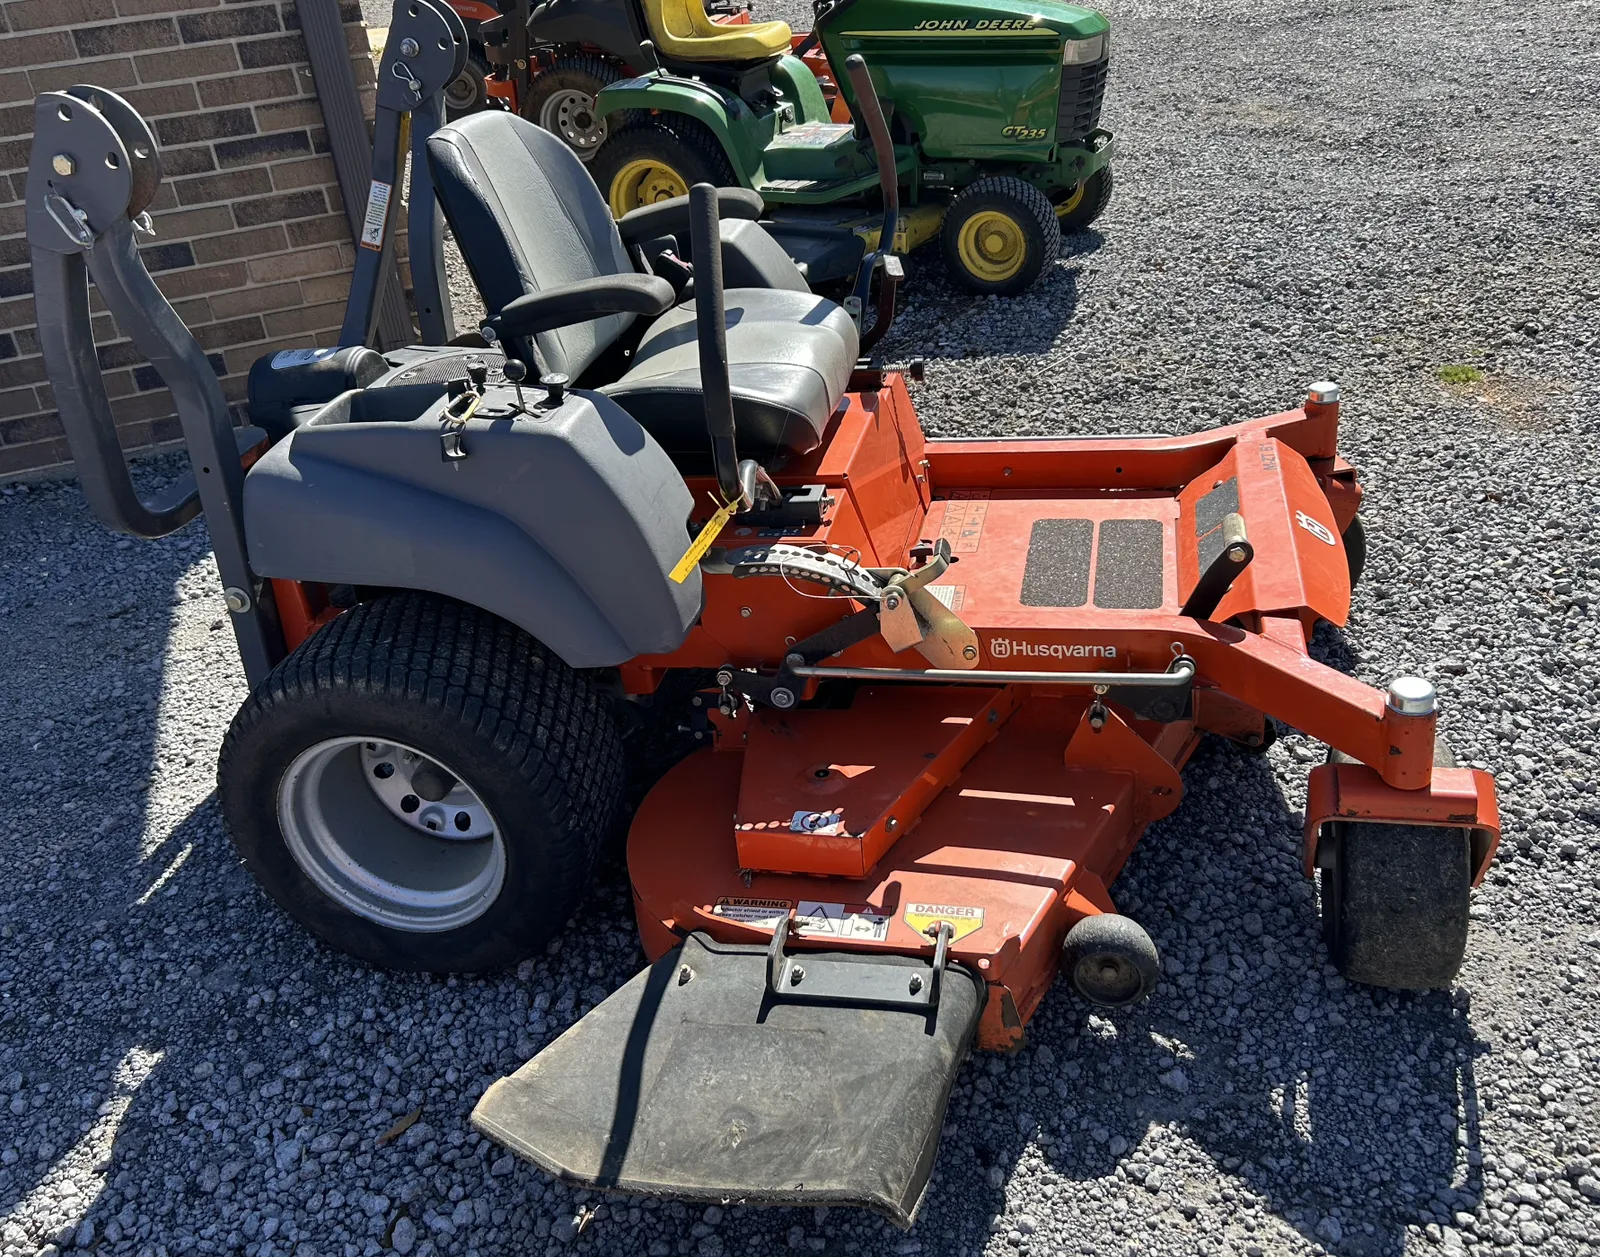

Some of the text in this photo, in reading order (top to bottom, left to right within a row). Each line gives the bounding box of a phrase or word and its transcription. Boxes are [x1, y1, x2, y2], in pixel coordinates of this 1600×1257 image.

[914, 19, 1036, 31] JOHN DEERE
[1001, 125, 1048, 140] GT235
[1013, 640, 1117, 659] Husqvarna
[733, 898, 788, 908] WARNING
[915, 904, 975, 917] DANGER
